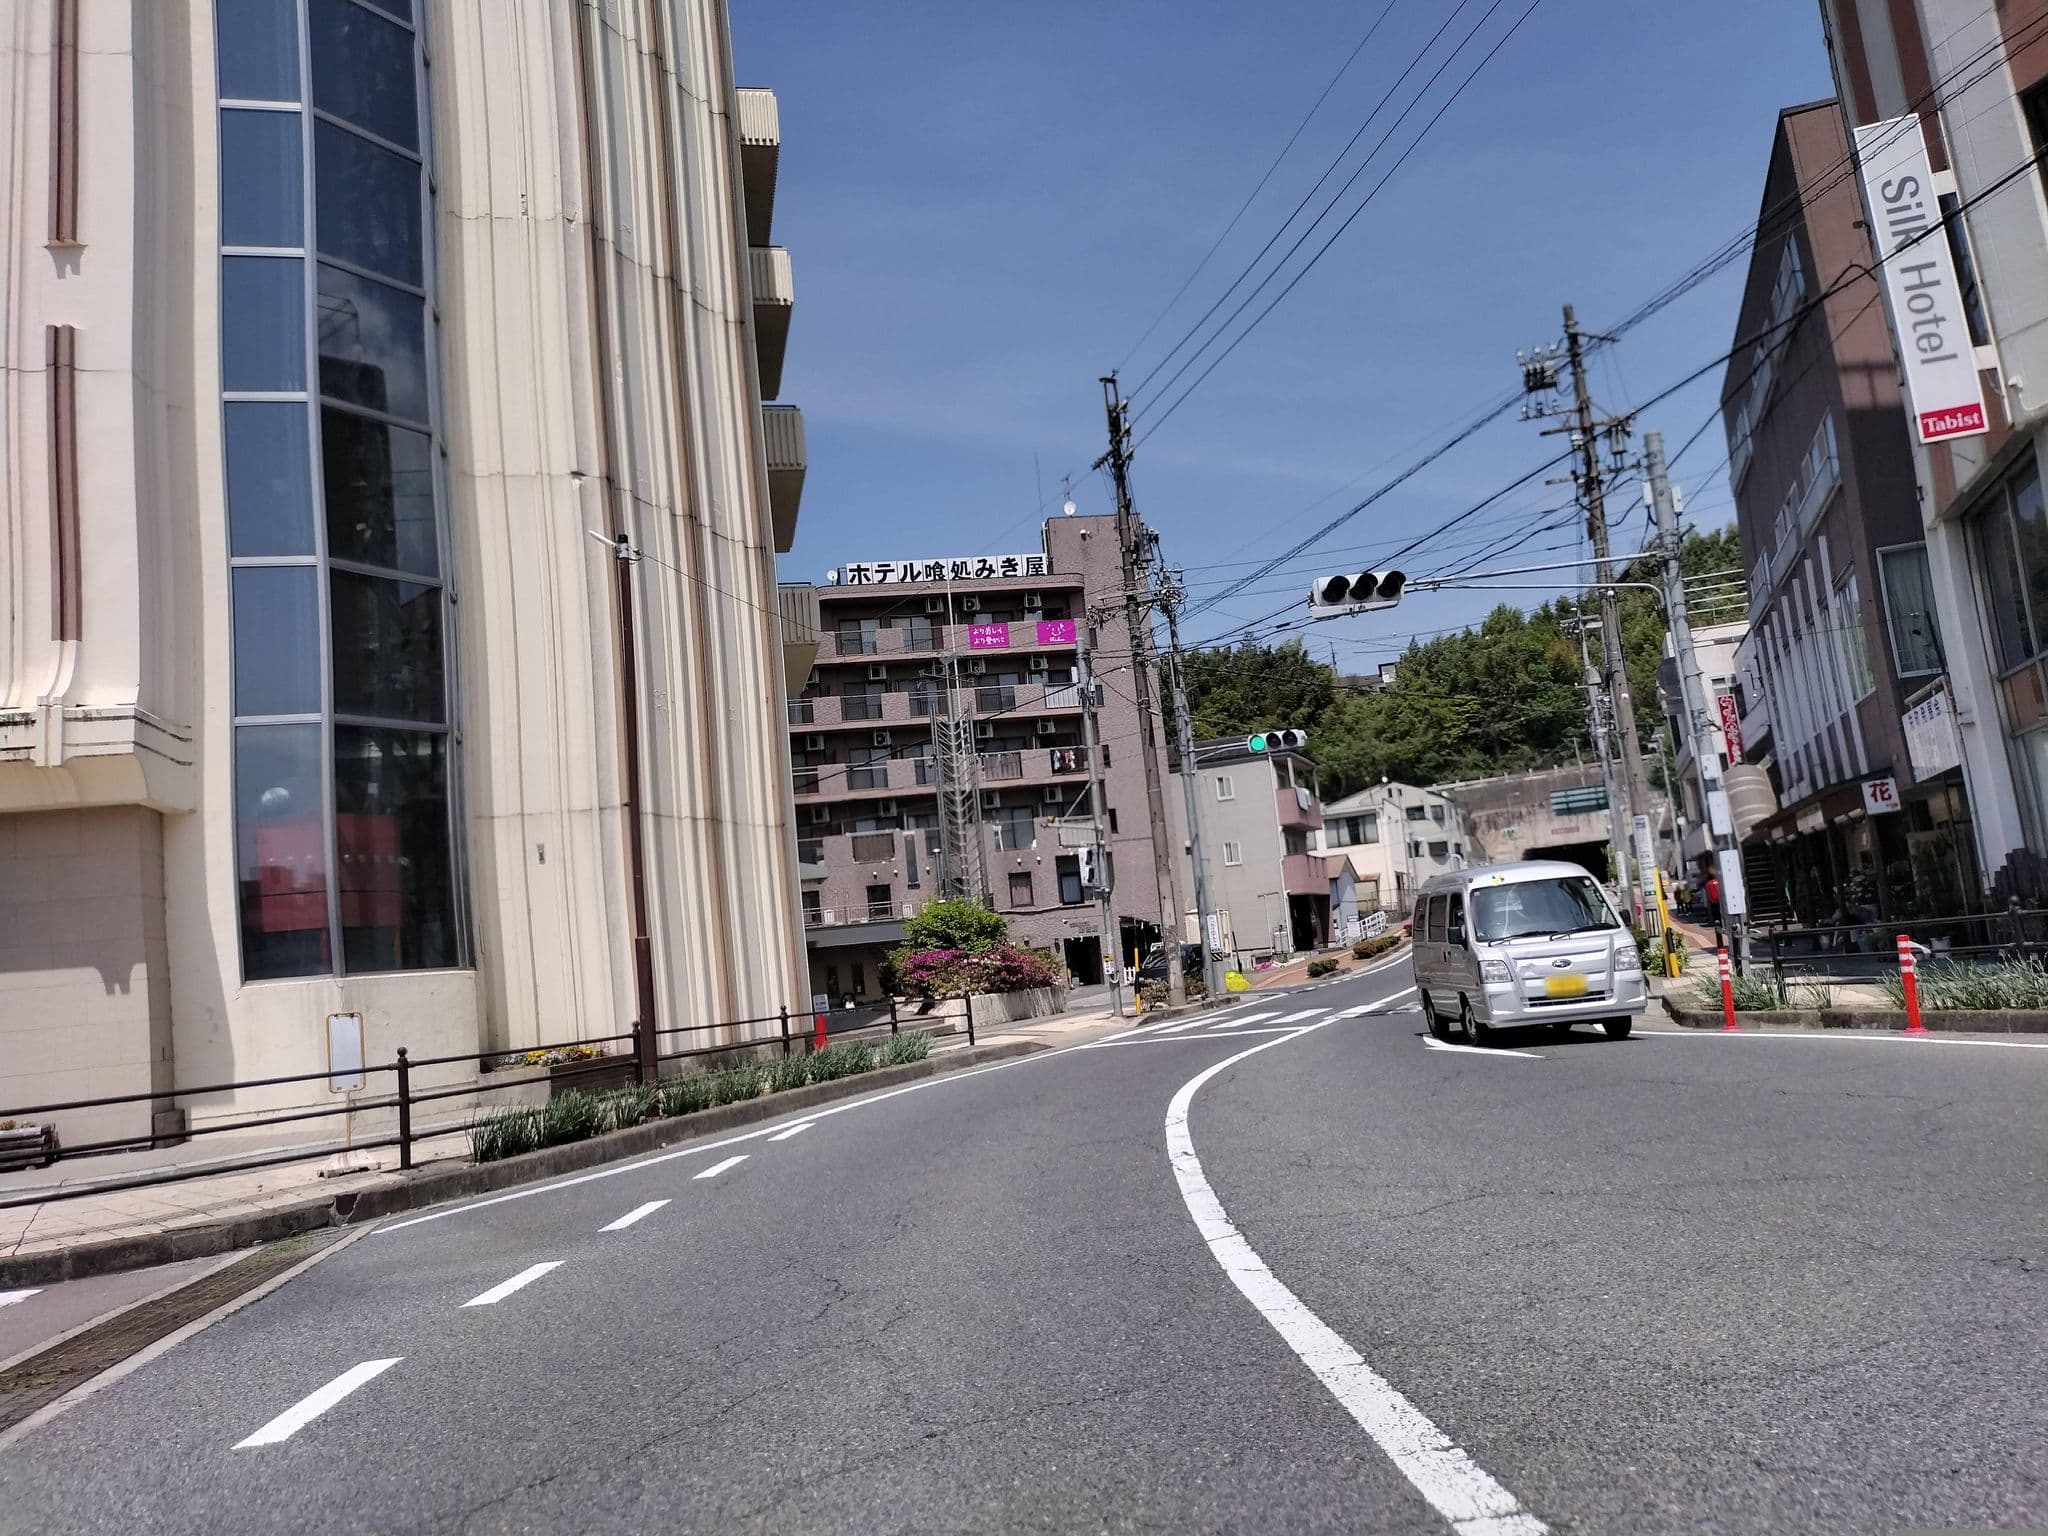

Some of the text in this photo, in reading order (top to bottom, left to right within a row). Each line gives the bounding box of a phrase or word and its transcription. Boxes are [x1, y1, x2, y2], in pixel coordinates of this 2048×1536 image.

[1880, 175, 1958, 366] Silk Hotel
[1923, 411, 1982, 434] Tabist
[848, 556, 1046, 585] ホテル喰処みき屋
[1868, 781, 1892, 803] 花
